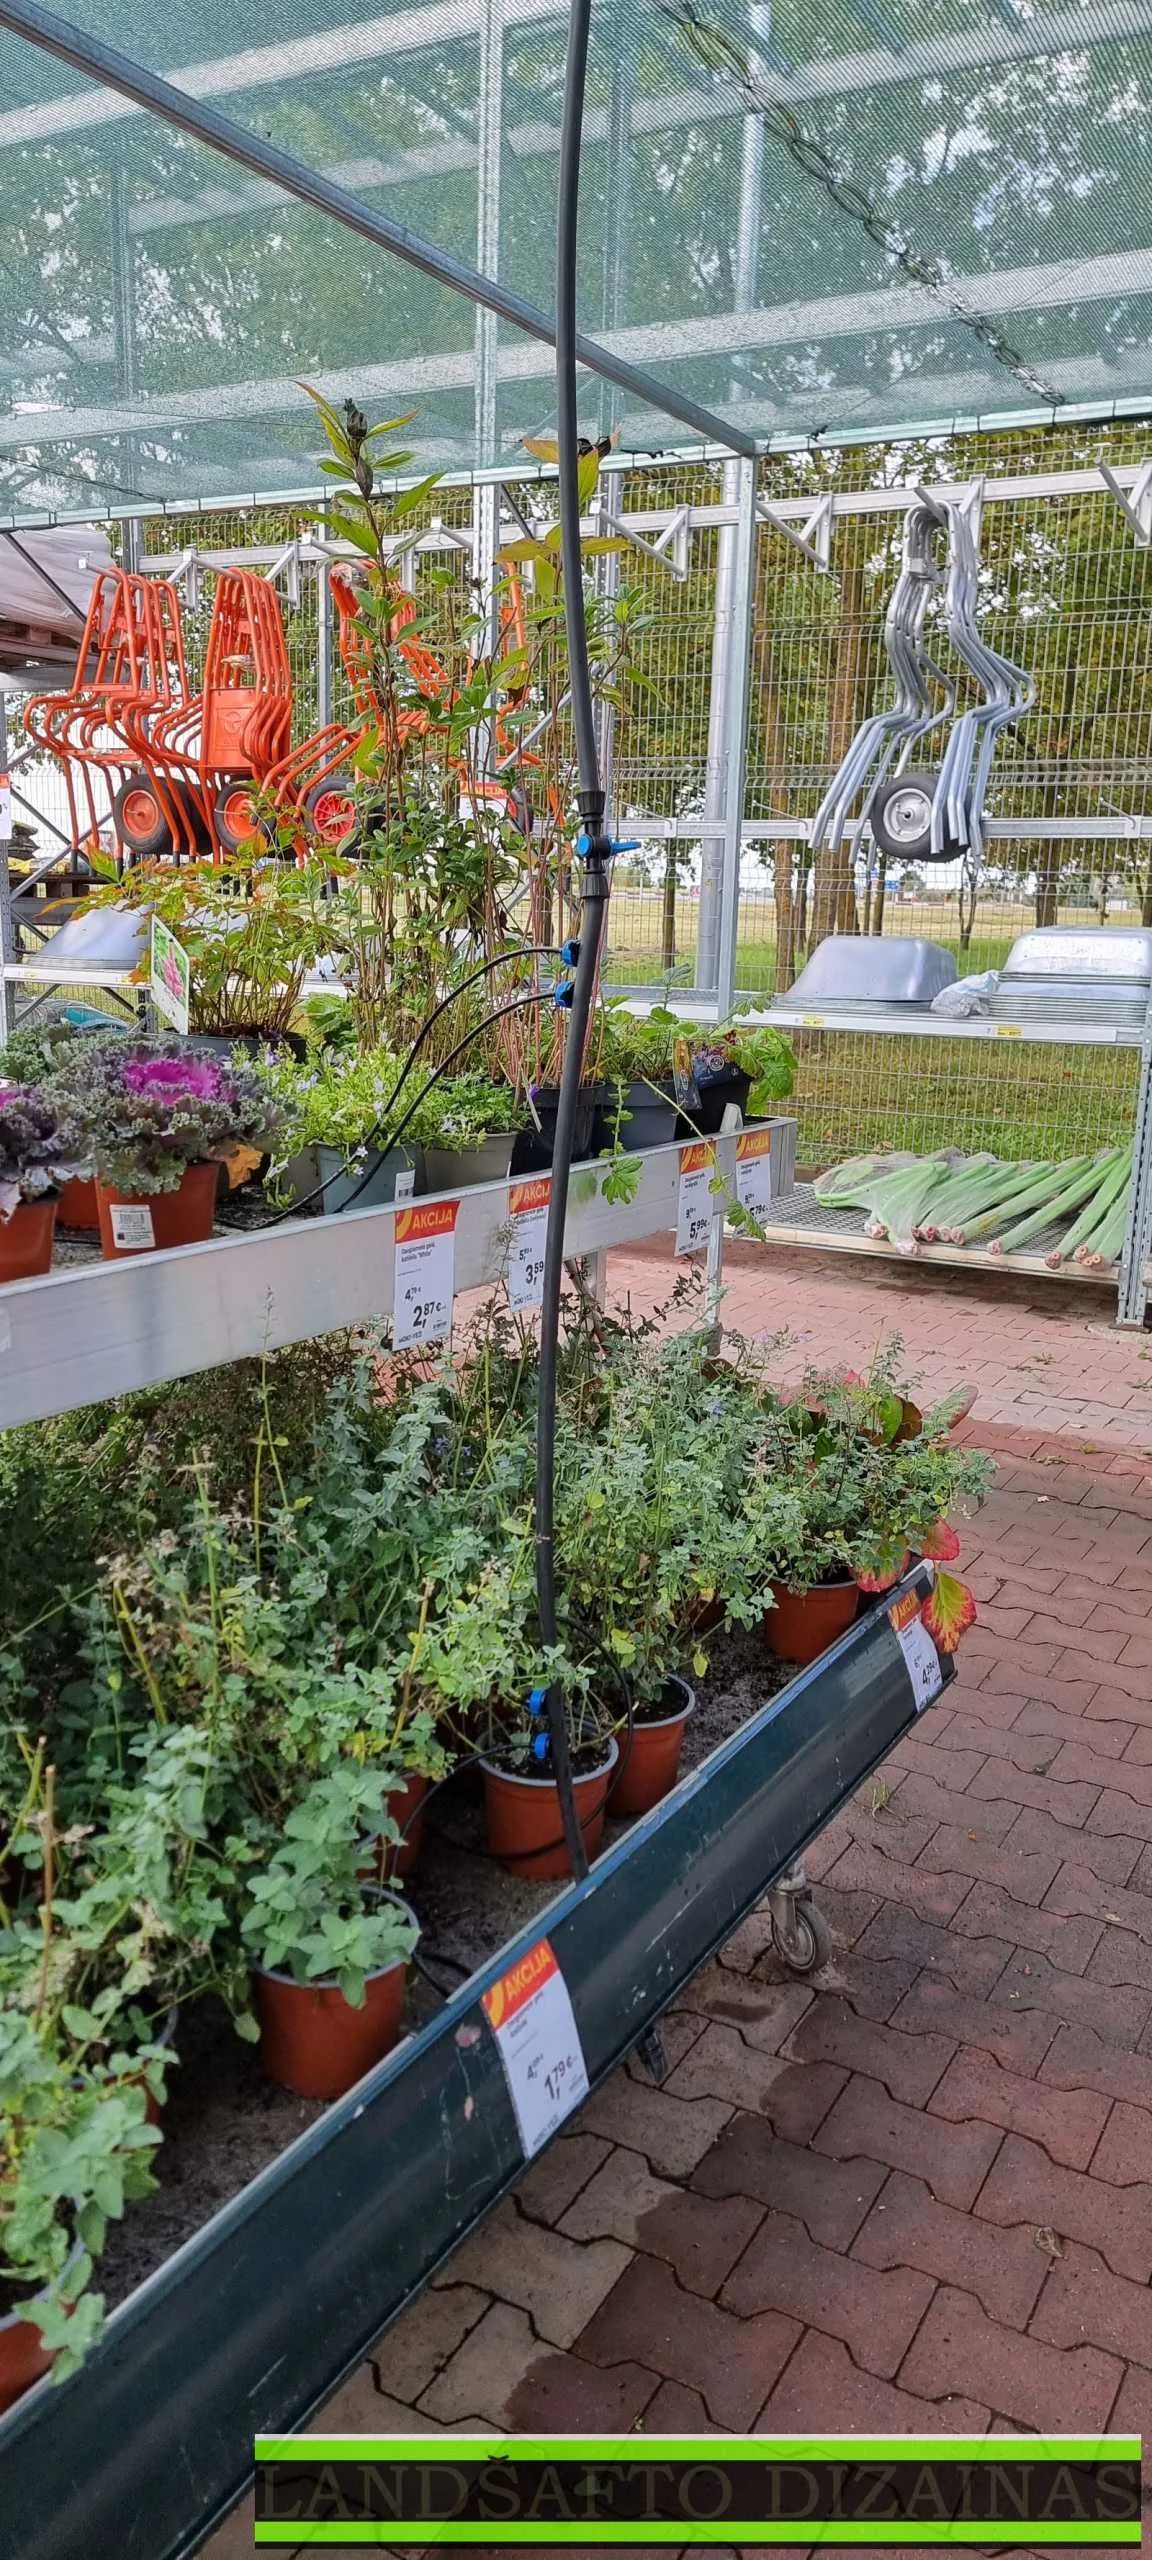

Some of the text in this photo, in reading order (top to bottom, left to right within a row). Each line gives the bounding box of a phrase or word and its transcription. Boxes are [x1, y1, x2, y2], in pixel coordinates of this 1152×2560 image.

[523, 1182, 551, 1201] AKCIJ
[412, 1208, 453, 1230] AKCIJA
[504, 1947, 552, 2001] AKCIJA
